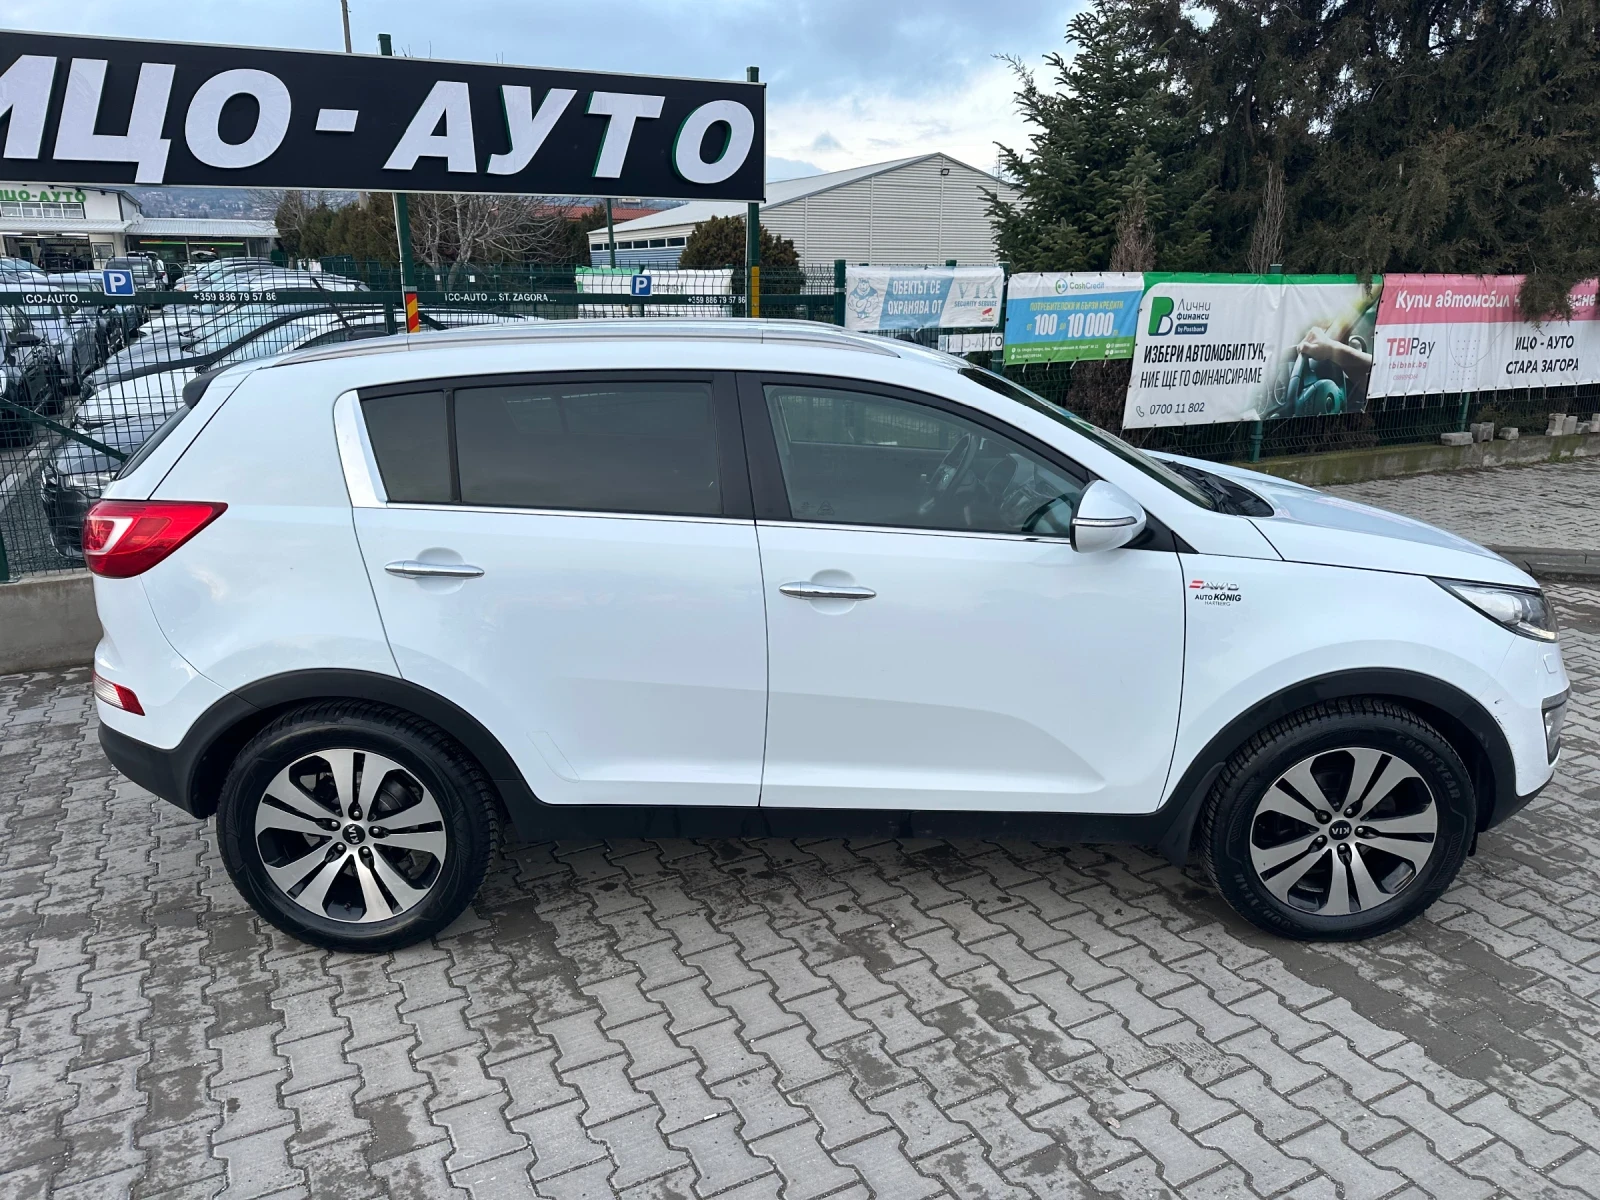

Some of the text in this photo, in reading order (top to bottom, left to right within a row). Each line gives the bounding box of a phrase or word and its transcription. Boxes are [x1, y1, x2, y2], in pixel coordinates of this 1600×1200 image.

[382, 80, 755, 184] АУТО
[892, 280, 941, 295] ОБЕКТЪТ СЕ
[1069, 281, 1105, 290] CashCredit
[193, 292, 217, 302] +359
[238, 292, 250, 302] 79
[252, 292, 263, 302] 57
[266, 292, 277, 301] 86
[513, 293, 549, 302] ZAGORA
[1177, 299, 1211, 311] Лични
[1395, 290, 1432, 313] Купи
[1435, 289, 1510, 309] автомобил
[888, 299, 943, 316] ОХРАНЯВА ОТ
[1034, 313, 1058, 336] 100
[1183, 325, 1204, 333] Postbank
[1386, 337, 1436, 359] TBIPay
[1515, 337, 1536, 352] ИЦО
[1546, 335, 1575, 350] АУТО
[1143, 343, 1267, 363] ИЗБЕРИ АВТОМОБИЛ ТУК,
[1505, 357, 1579, 375] СТАРА ЗАГОРА
[1140, 367, 1262, 390] НИЕ ЩЕ ГО ФИНАНСИРАМЕ
[1150, 402, 1205, 415] 0700 11 802
[1213, 592, 1242, 602] KÖNIG
